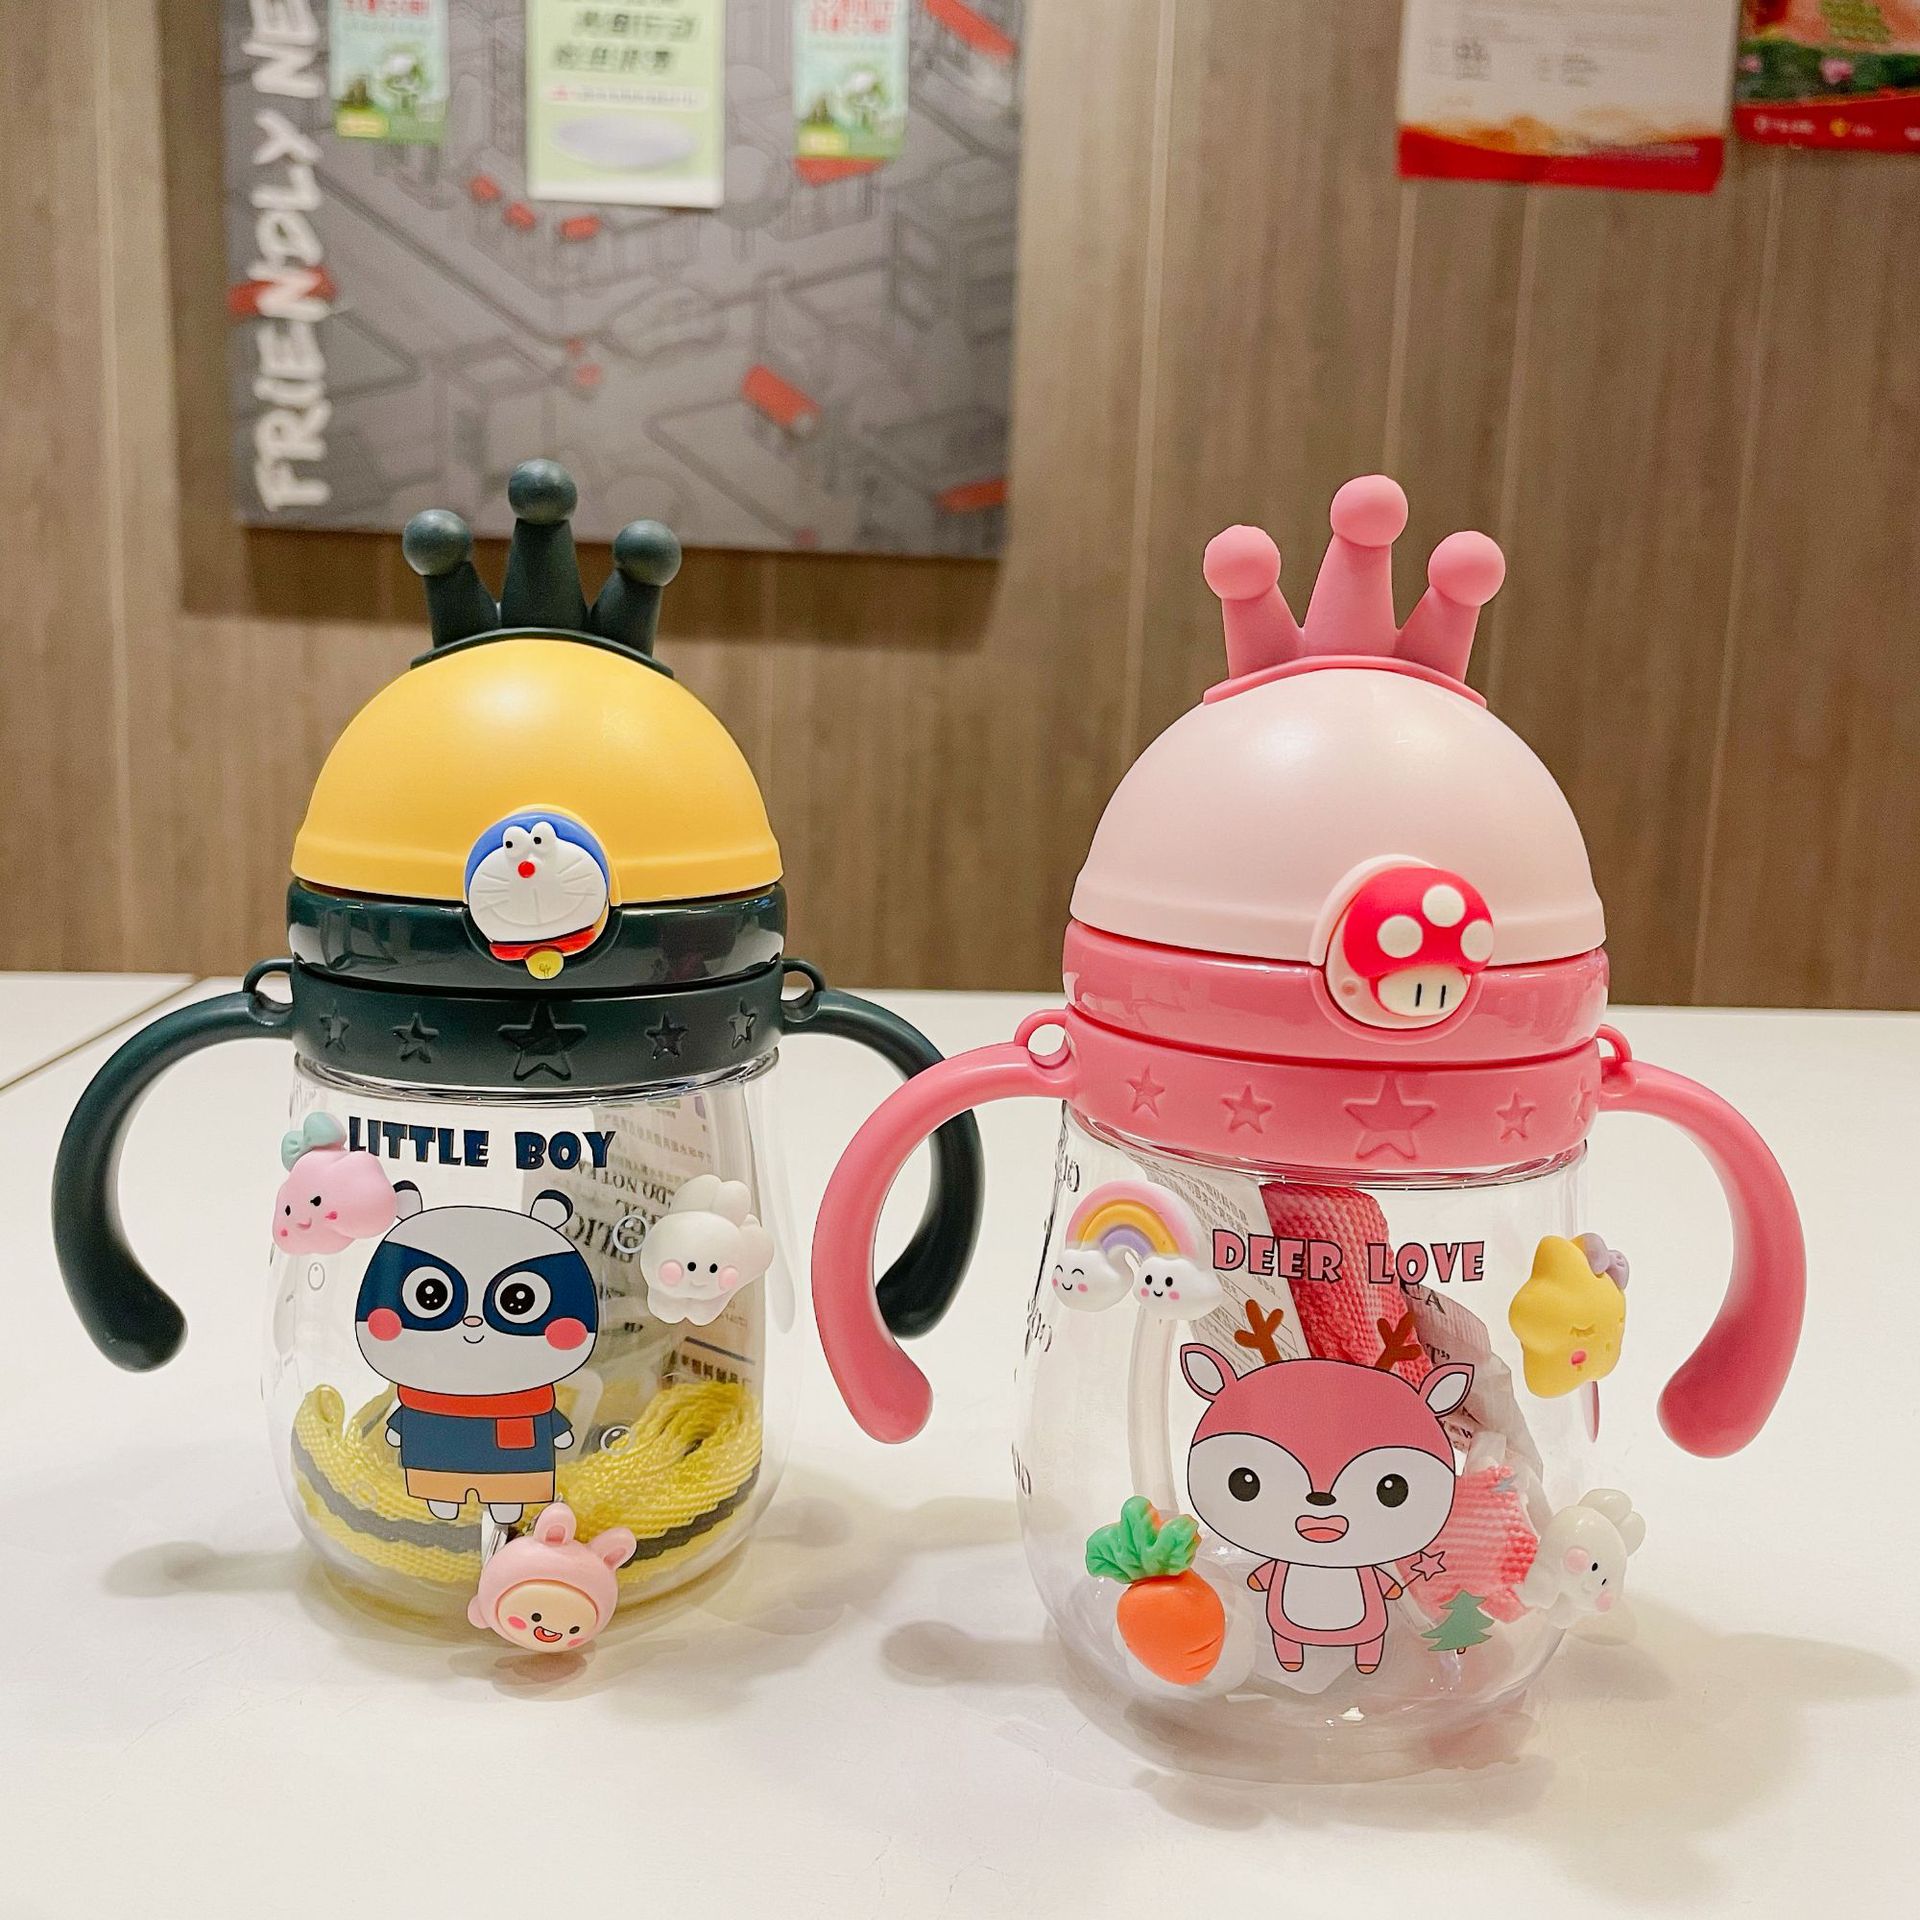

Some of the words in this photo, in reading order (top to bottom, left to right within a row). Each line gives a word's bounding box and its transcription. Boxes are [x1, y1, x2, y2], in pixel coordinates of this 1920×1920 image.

[250, 109, 331, 511] FRIENDLY
[348, 1115, 490, 1168] LITTLE
[514, 1131, 616, 1171] BOY
[1212, 1228, 1343, 1283] DEER
[1367, 1240, 1485, 1286] LOVE
